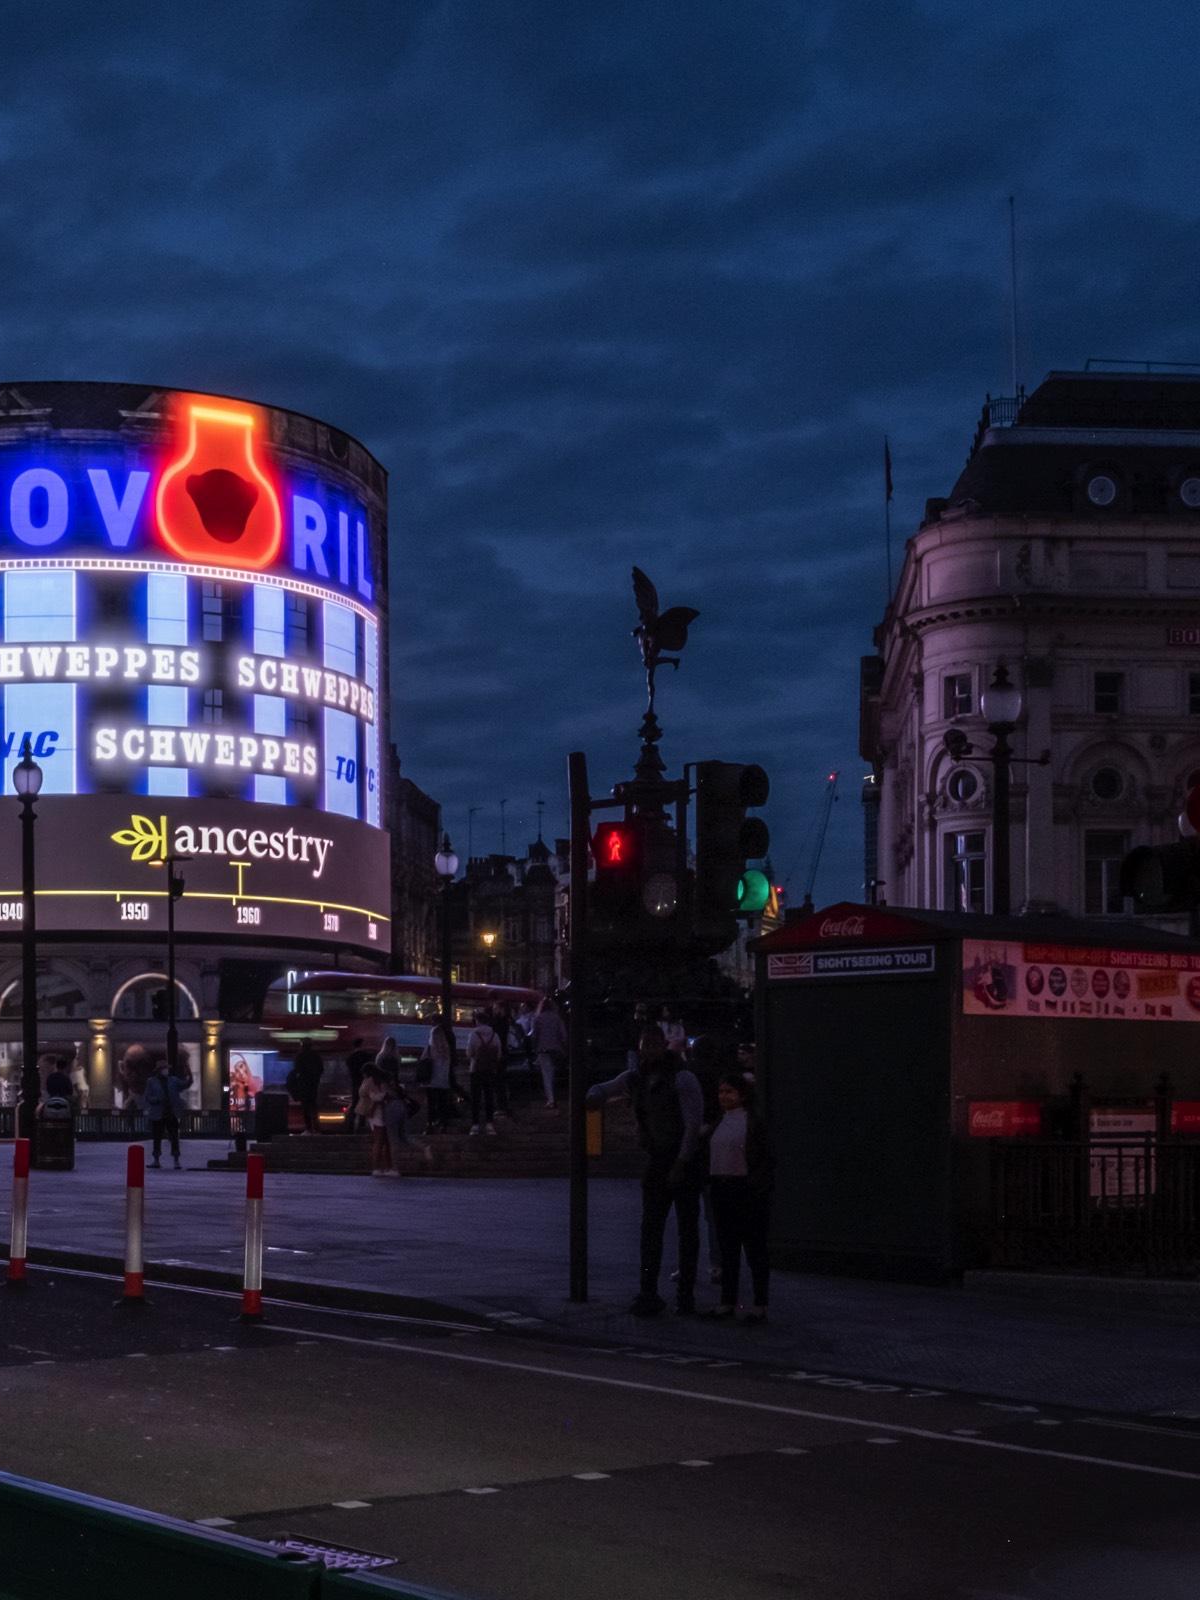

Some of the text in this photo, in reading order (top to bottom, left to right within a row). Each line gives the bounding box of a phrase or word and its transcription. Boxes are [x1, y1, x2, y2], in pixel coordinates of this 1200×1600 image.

[239, 657, 374, 720] SCHWEPPES
[95, 728, 317, 776] SCHWEPPES
[174, 823, 329, 877] ancestry
[121, 902, 149, 921] 1950
[236, 906, 260, 925] 1960
[816, 952, 928, 969] SIGHTSEEING TOUR
[1110, 951, 1168, 968] SIGHTSEEING
